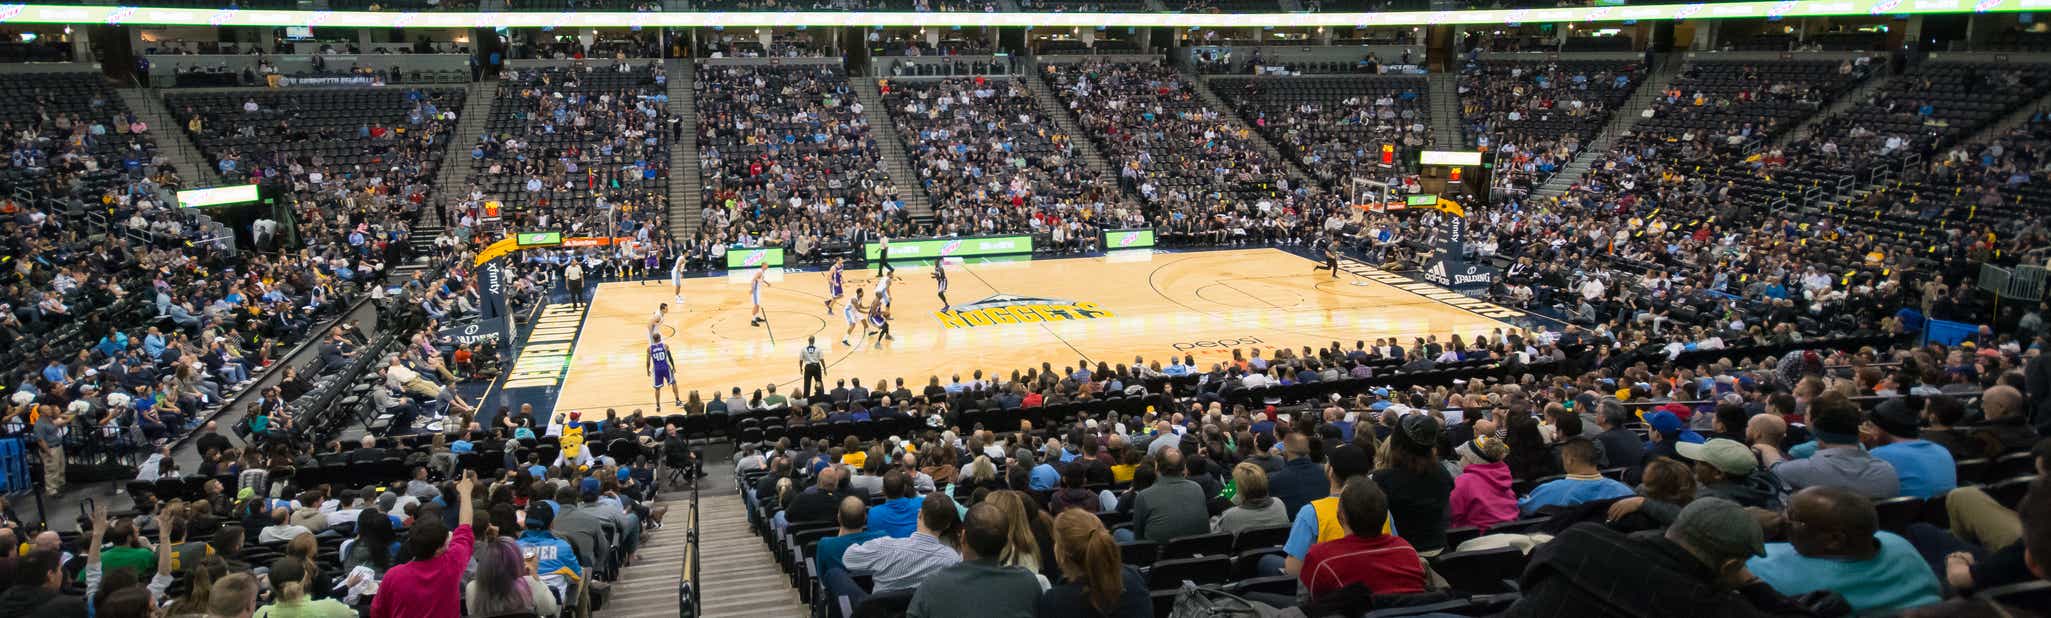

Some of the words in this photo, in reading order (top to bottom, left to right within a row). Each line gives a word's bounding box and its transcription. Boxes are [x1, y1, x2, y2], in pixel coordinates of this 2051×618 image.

[487, 263, 500, 294] xfinity
[1454, 272, 1490, 285] SPALDING
[932, 301, 1116, 329] NUGGETS
[1172, 336, 1264, 351] pepsi
